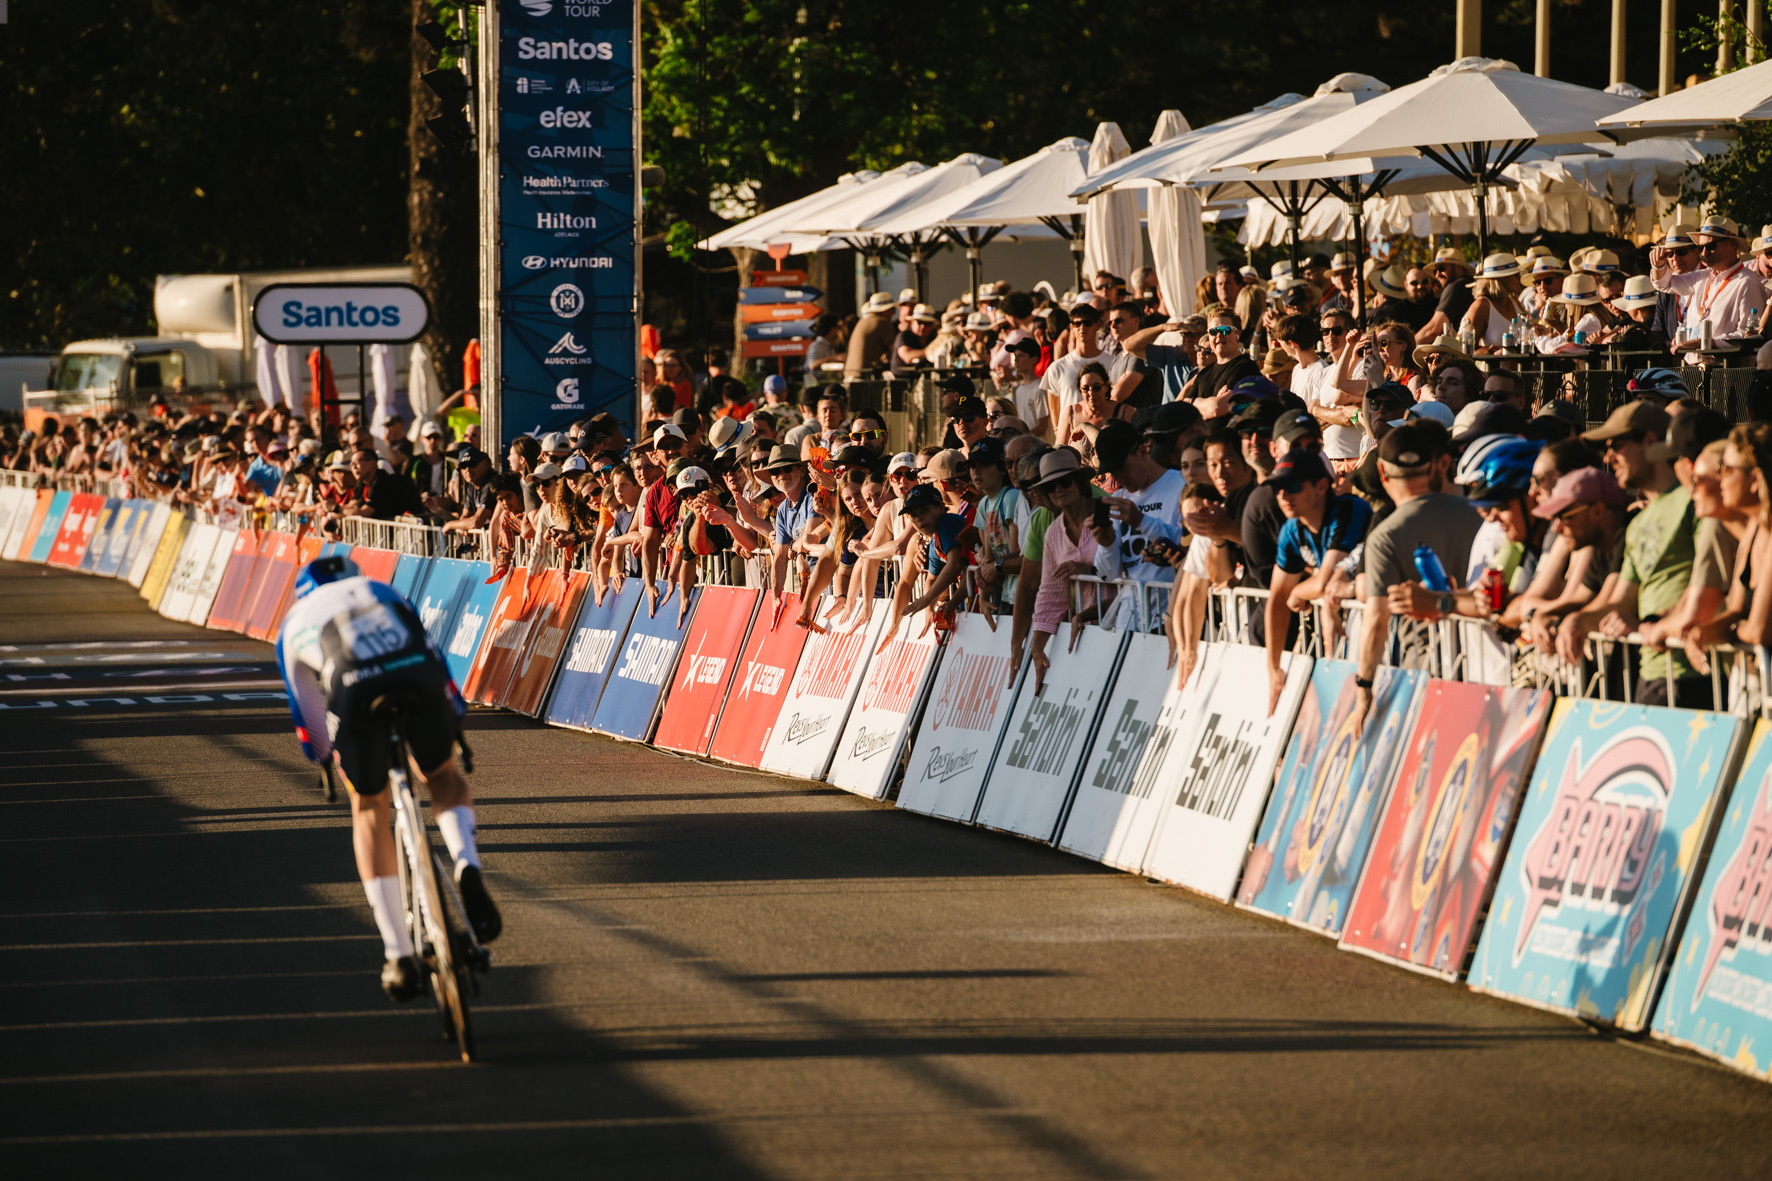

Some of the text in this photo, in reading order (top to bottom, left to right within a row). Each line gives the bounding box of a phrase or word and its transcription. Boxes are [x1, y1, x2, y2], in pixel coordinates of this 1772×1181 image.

[564, 6, 600, 17] TOUR
[518, 37, 613, 60] Santos
[540, 106, 592, 128] efex
[523, 176, 609, 188] Health Partners
[537, 212, 597, 229] Hilton
[550, 257, 613, 269] HYUNDAI
[283, 300, 401, 328] Santos
[544, 357, 592, 365] AUSCYCLING
[356, 625, 402, 657] 115
[565, 627, 618, 674] SHIMANO
[696, 655, 727, 685] LEGEND
[753, 662, 786, 696] LEGEND
[806, 631, 867, 700] YAMAHA
[872, 640, 931, 715] YAMAHA
[945, 653, 1013, 732] YAMAHA
[1006, 682, 1094, 777] Santini
[1092, 698, 1186, 800] Santini
[1175, 712, 1270, 821] Santini
[1538, 796, 1663, 905] BARRY
